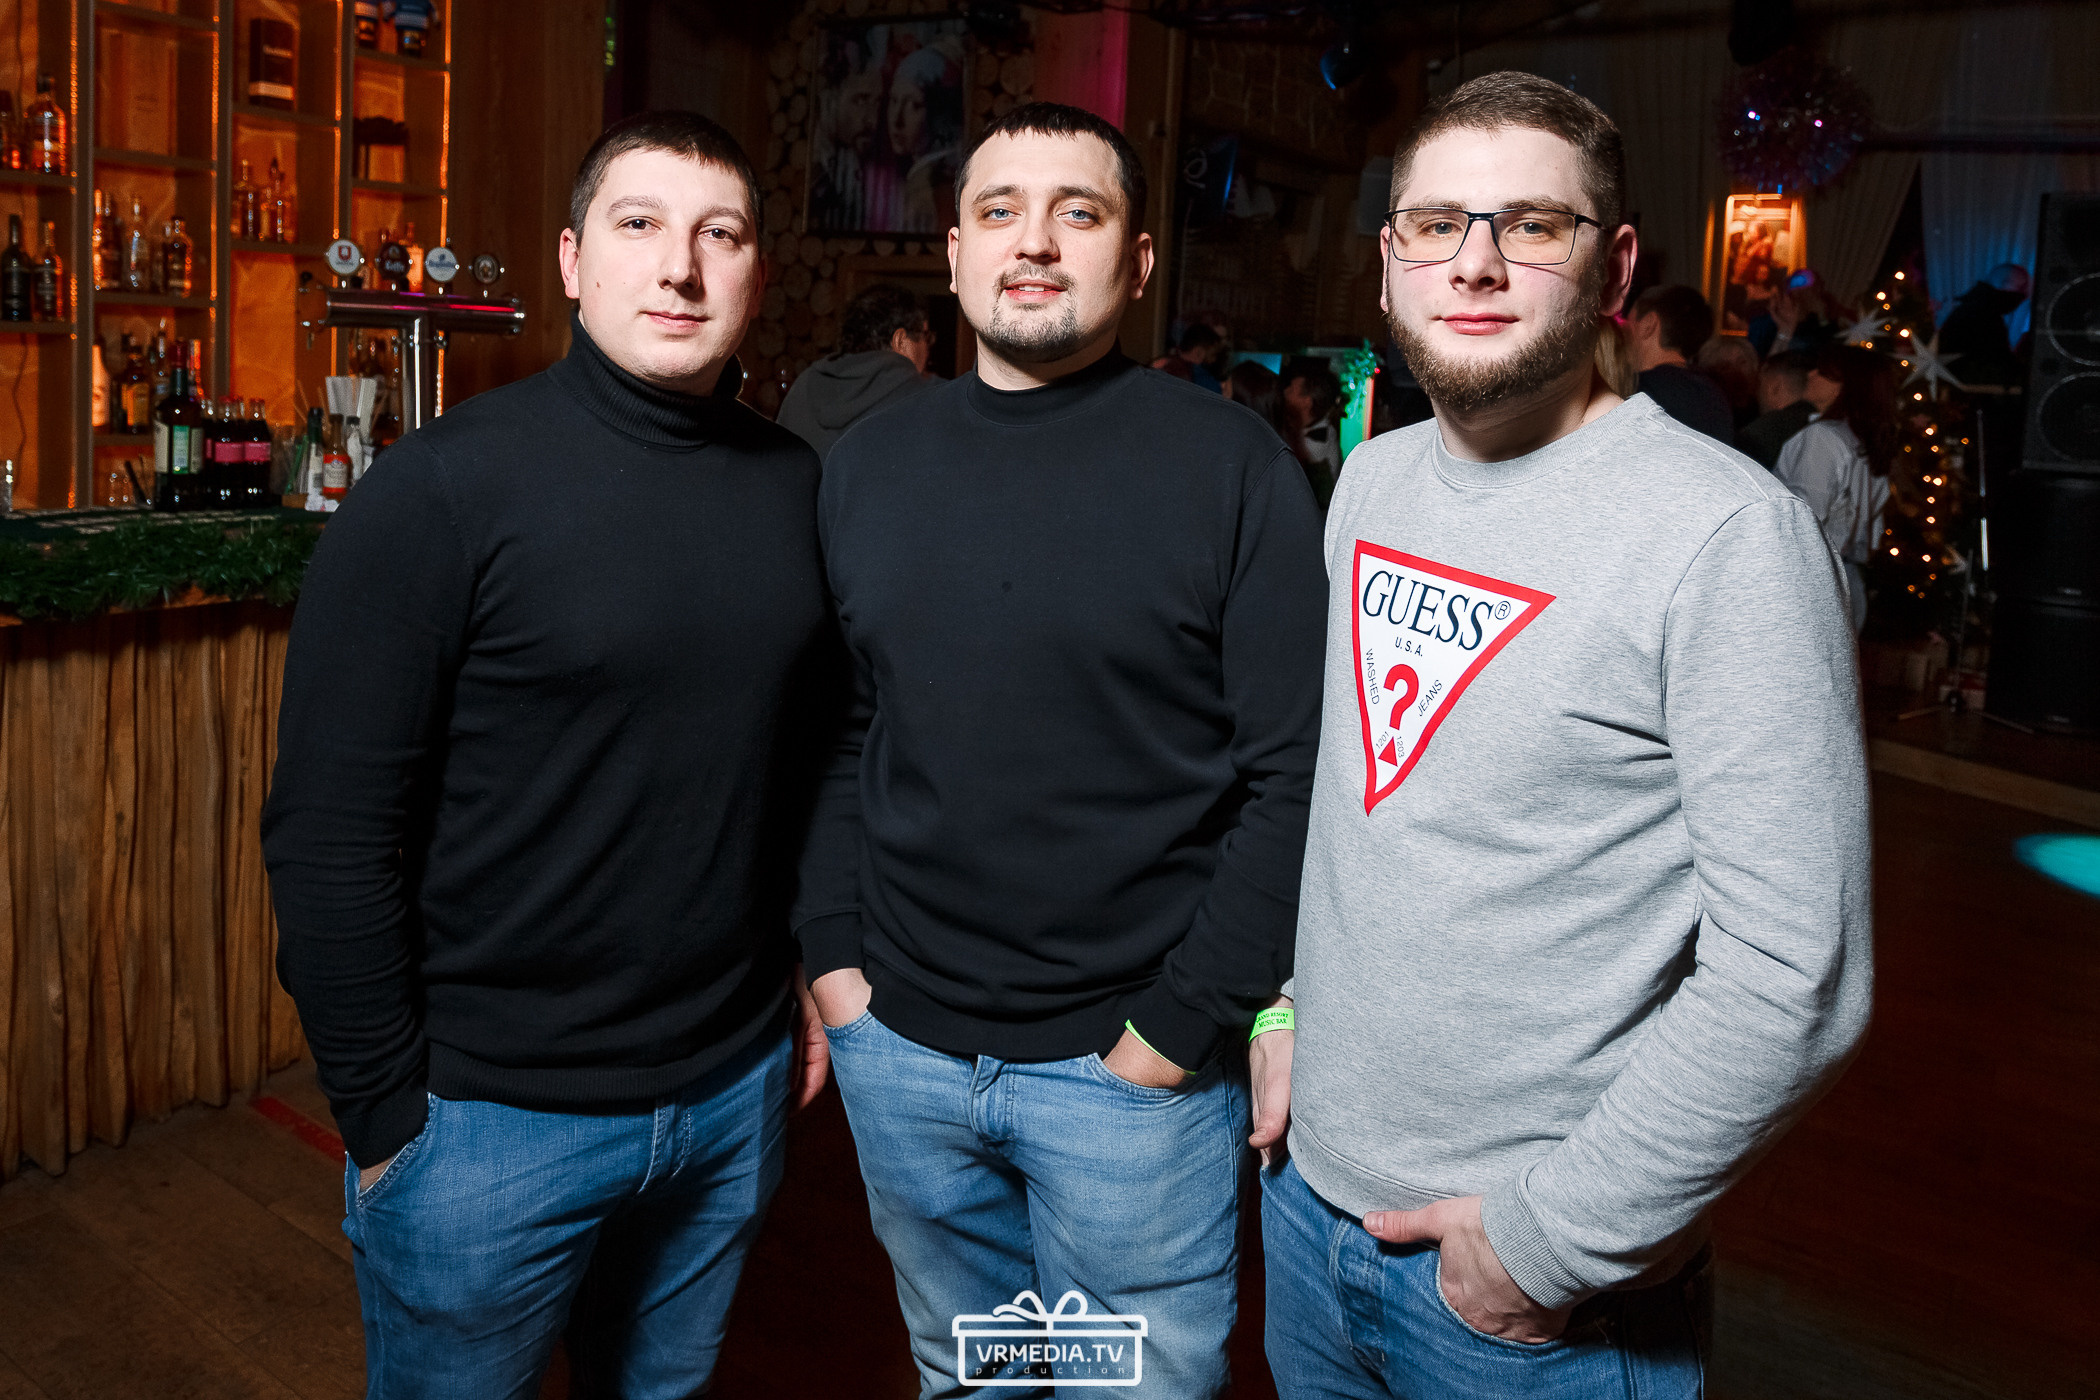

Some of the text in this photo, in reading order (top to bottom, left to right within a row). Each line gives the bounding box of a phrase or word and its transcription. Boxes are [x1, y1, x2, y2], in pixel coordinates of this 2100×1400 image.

[1395, 636, 1423, 657] U.S.A.
[1365, 648, 1380, 705] WASHED
[1417, 679, 1443, 717] JEANS
[1375, 731, 1389, 749] 1201
[1397, 736, 1405, 758] 1203
[1258, 1018, 1275, 1028] MUSIC
